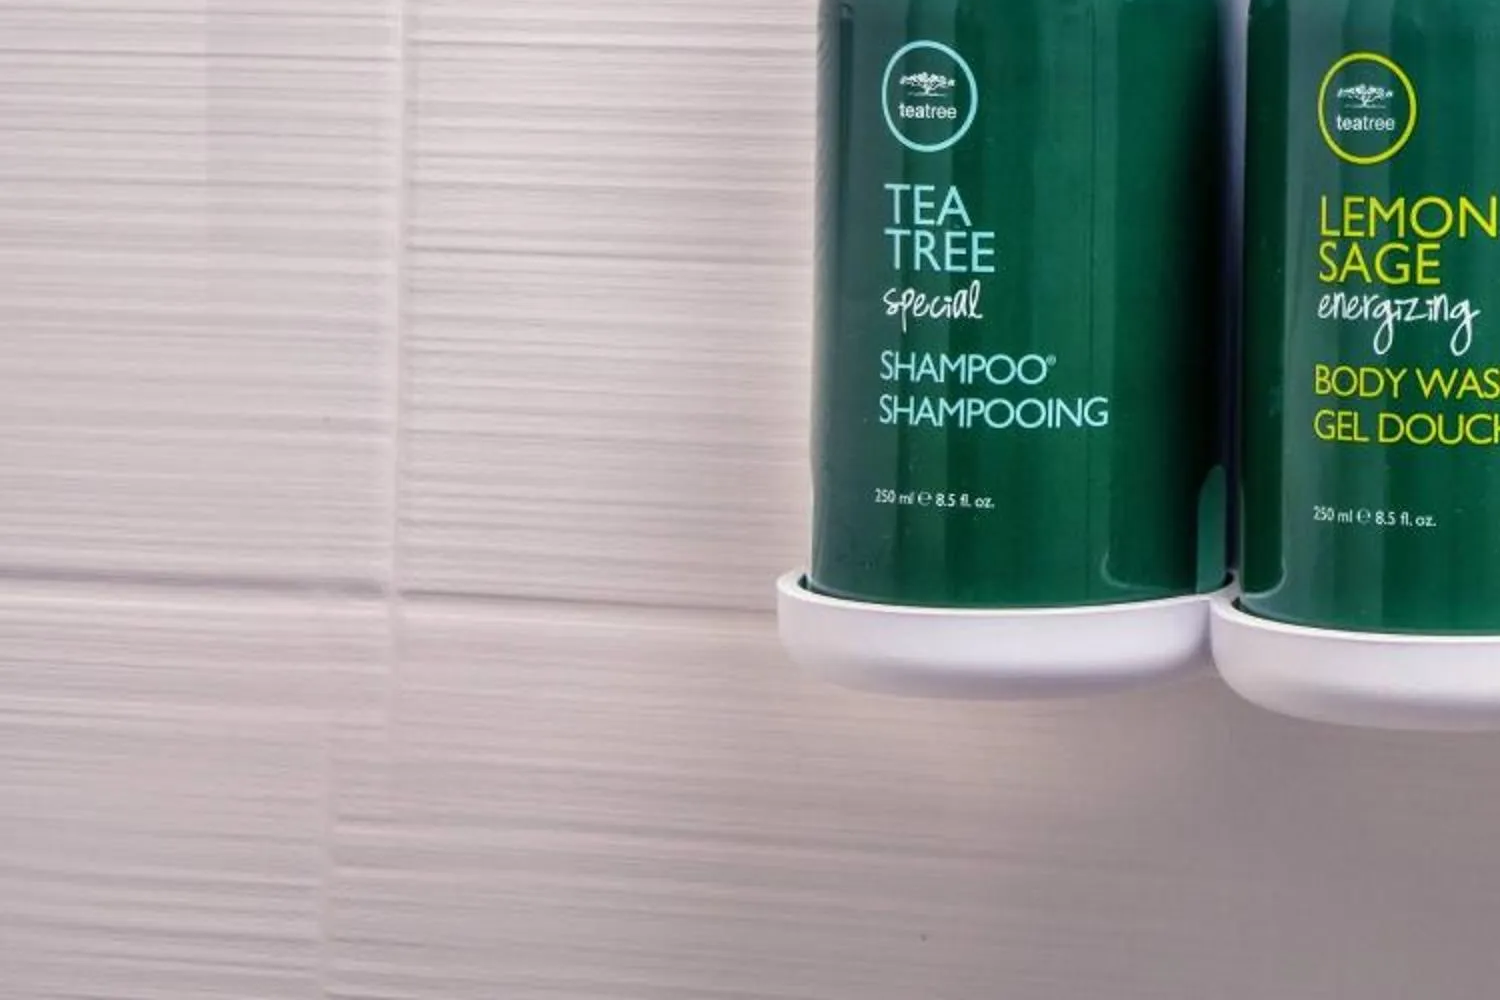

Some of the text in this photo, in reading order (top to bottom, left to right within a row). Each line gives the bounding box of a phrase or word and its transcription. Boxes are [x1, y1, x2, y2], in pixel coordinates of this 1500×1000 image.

[899, 103, 957, 120] teatree
[1337, 115, 1395, 132] teatree
[884, 183, 971, 227] TEA
[1320, 195, 1497, 239] LEMON
[884, 228, 995, 273] TREE
[1319, 241, 1441, 285] SAGE
[883, 279, 983, 333] special
[1317, 292, 1481, 357] energizing
[1315, 364, 1407, 398] BODY
[879, 394, 1109, 429] SHAMPOOING
[1314, 409, 1369, 442] GEL
[874, 488, 896, 504] 250
[899, 491, 915, 505] ml
[935, 493, 956, 507] 8.5
[1313, 505, 1335, 521] 250
[1338, 508, 1353, 523] ml
[1375, 510, 1396, 525] 8.5
[1415, 515, 1436, 527] oz.
